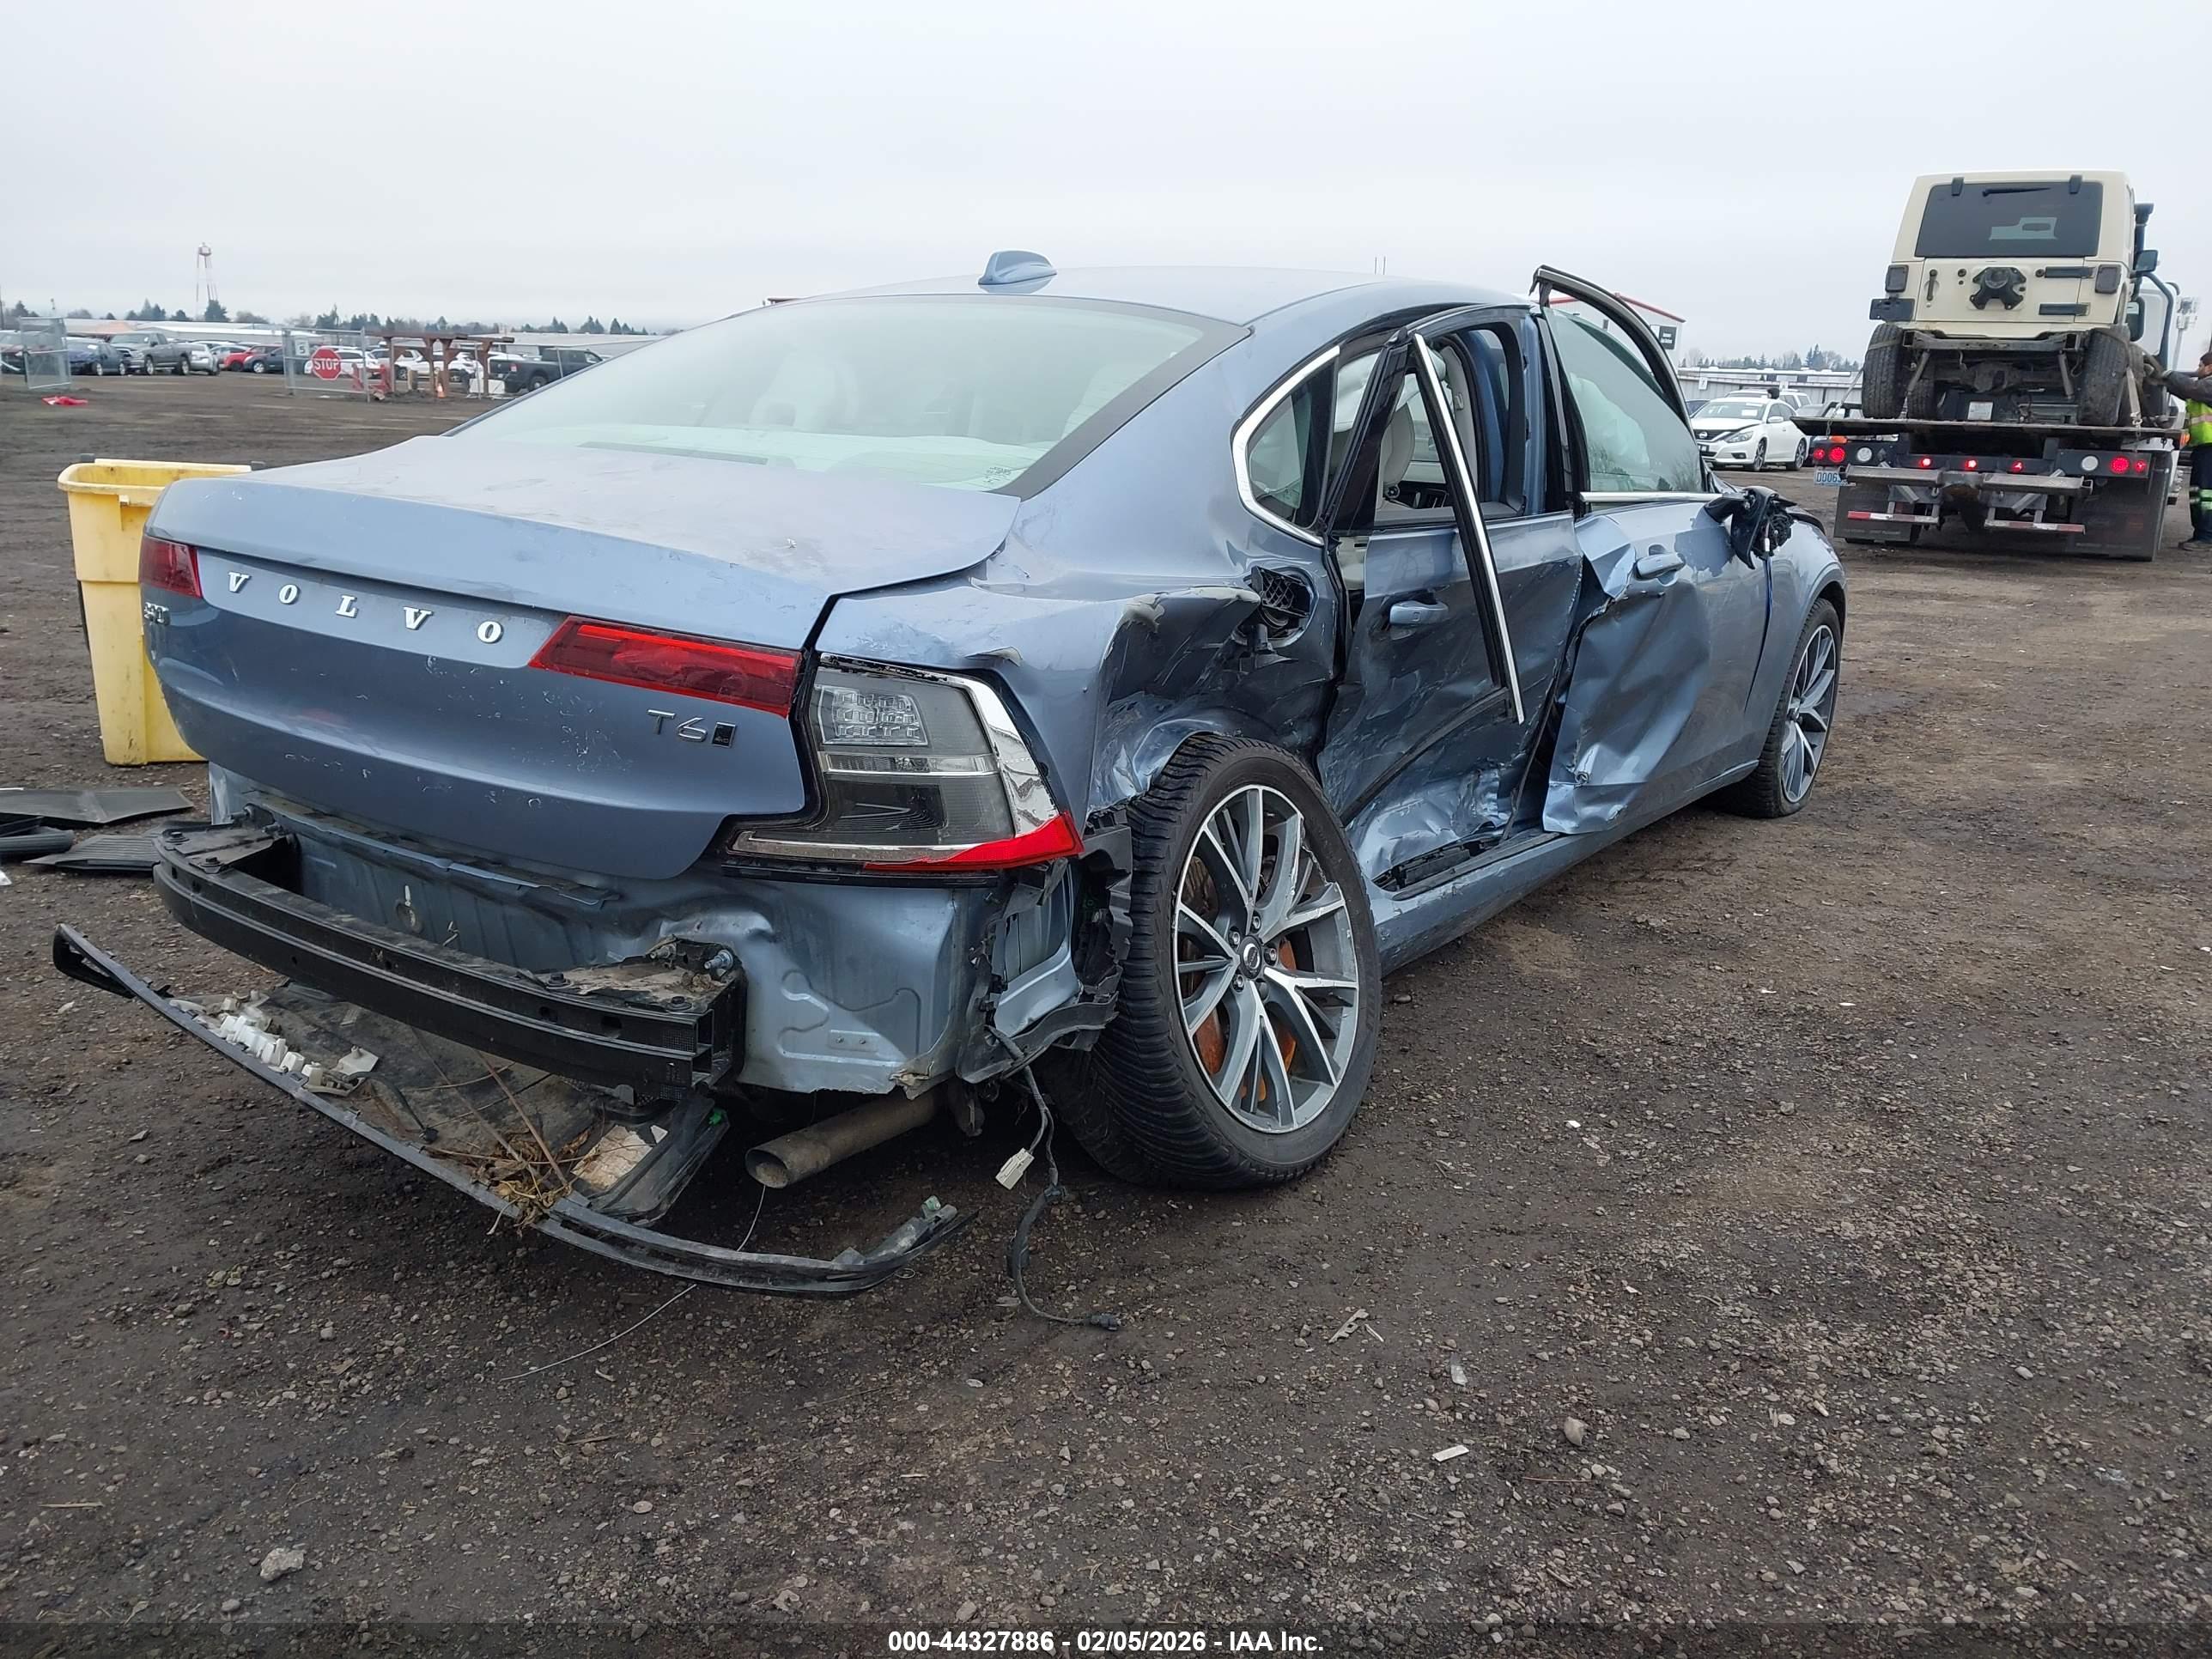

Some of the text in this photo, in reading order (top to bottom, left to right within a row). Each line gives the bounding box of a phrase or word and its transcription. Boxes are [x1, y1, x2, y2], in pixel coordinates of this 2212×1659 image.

[313, 357, 340, 371] STOP
[228, 571, 504, 644] VOLVO
[646, 708, 708, 743] T6
